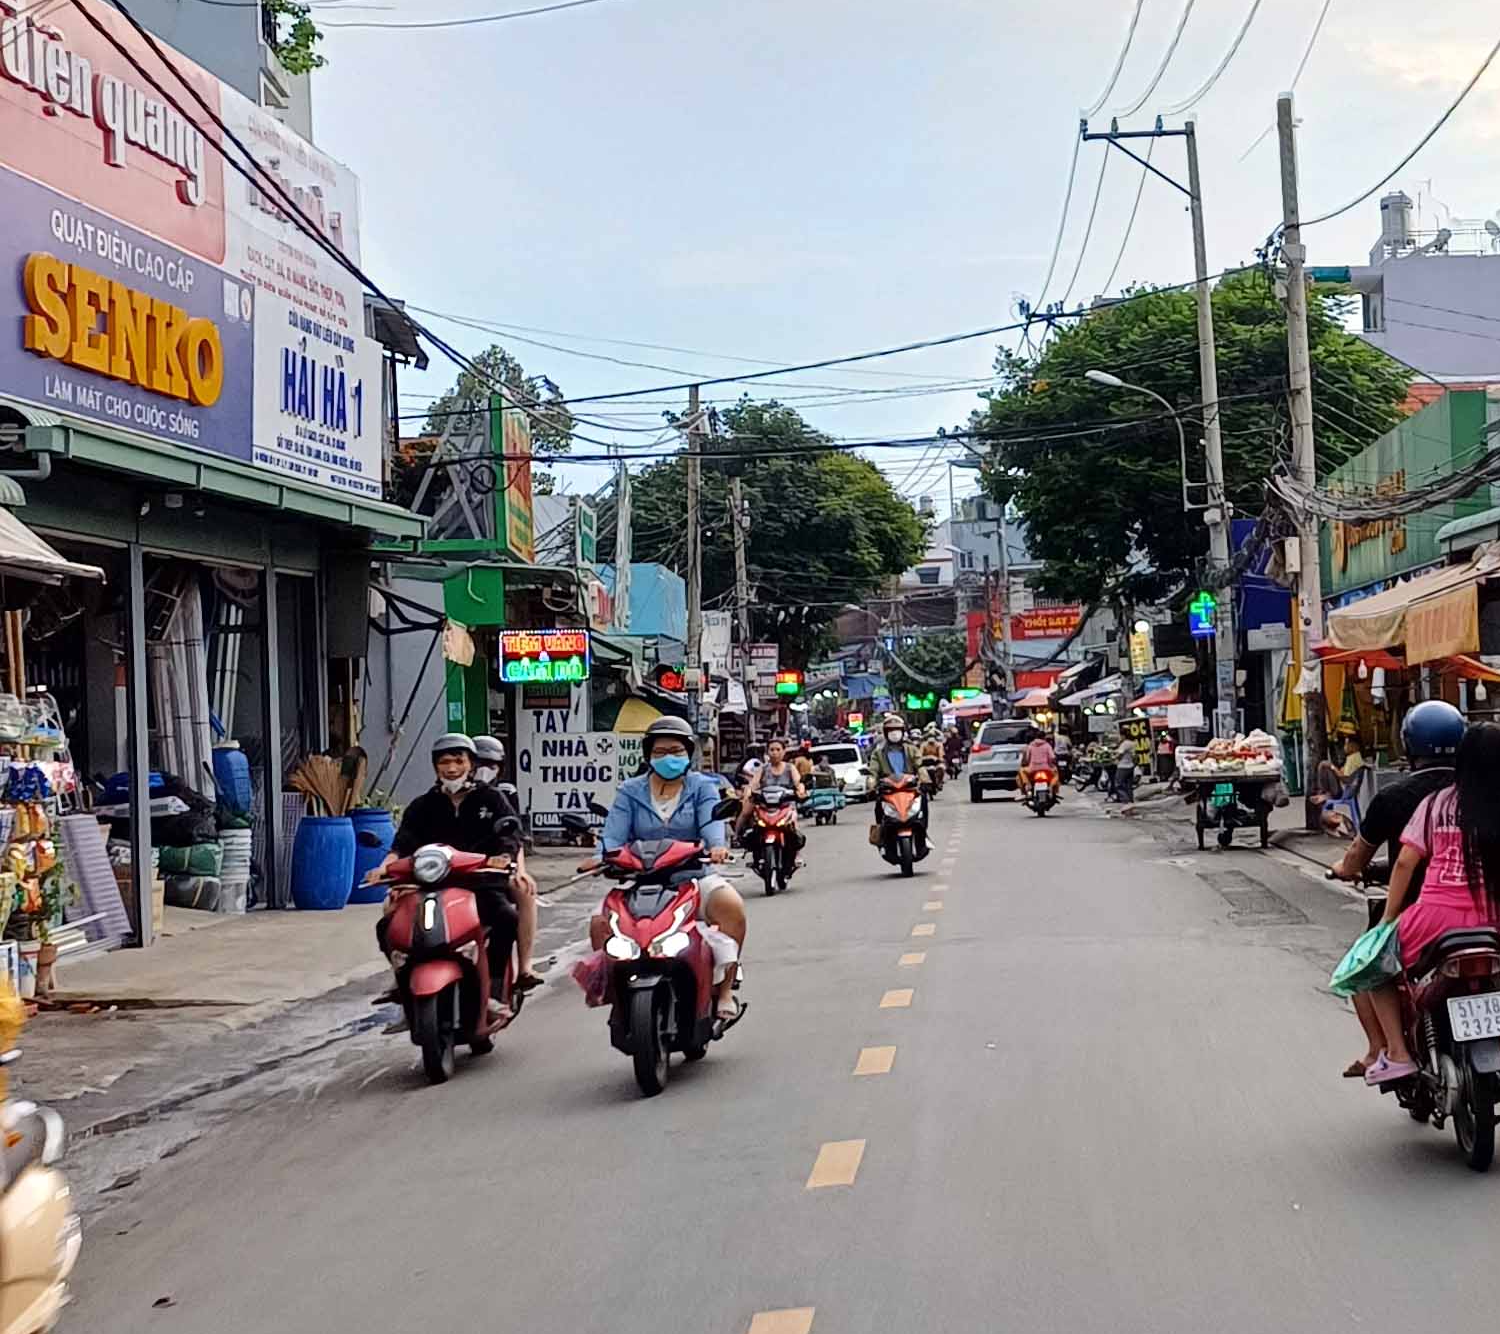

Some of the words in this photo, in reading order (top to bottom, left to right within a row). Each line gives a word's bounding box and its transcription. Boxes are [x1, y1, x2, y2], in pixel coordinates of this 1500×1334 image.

[92, 74, 205, 207] quang
[51, 209, 95, 254] QUẠT
[134, 248, 164, 282] CAO
[24, 251, 223, 407] SENKO
[45, 375, 73, 403] LÀM
[76, 384, 102, 414] MÁT
[104, 395, 132, 420] CHO
[134, 403, 167, 430] CUỘC
[168, 408, 200, 438] SỐNG
[280, 336, 316, 422] HẢI
[319, 354, 348, 434] HÀ
[351, 378, 362, 438] 1
[539, 759, 612, 783] THUỐC
[541, 736, 589, 757] NHÀ
[554, 788, 595, 809] TÂY
[1457, 997, 1500, 1018] 51-X8
